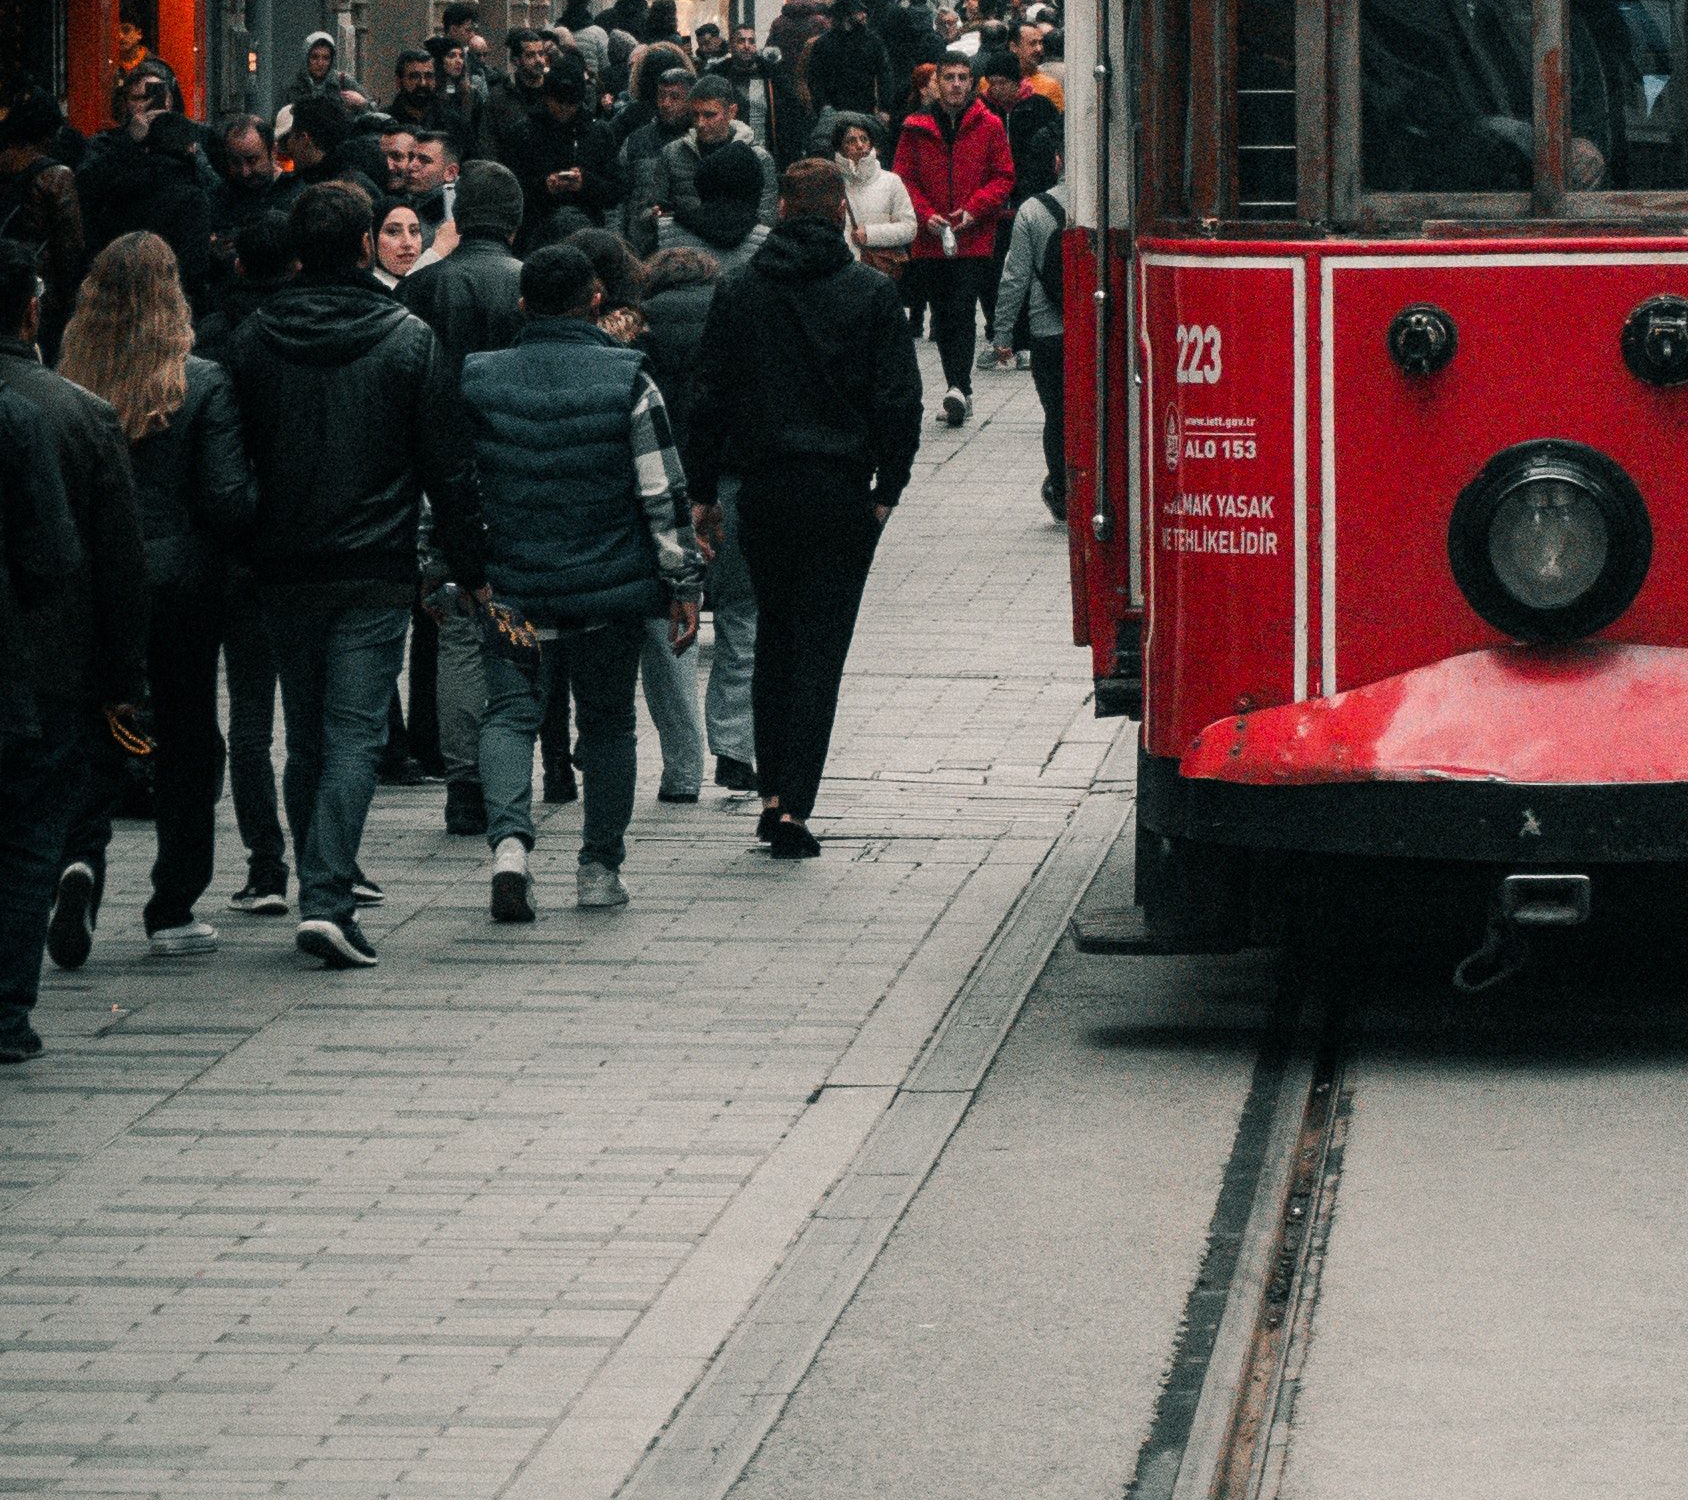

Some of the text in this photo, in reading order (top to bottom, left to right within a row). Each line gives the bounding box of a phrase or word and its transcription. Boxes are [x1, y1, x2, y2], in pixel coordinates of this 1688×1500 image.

[1176, 324, 1222, 384] 223
[1184, 440, 1217, 459] ALO
[1222, 440, 1257, 459] 153
[1216, 495, 1274, 519] YASAK
[1173, 525, 1277, 556] TEHLİKELİDİR
